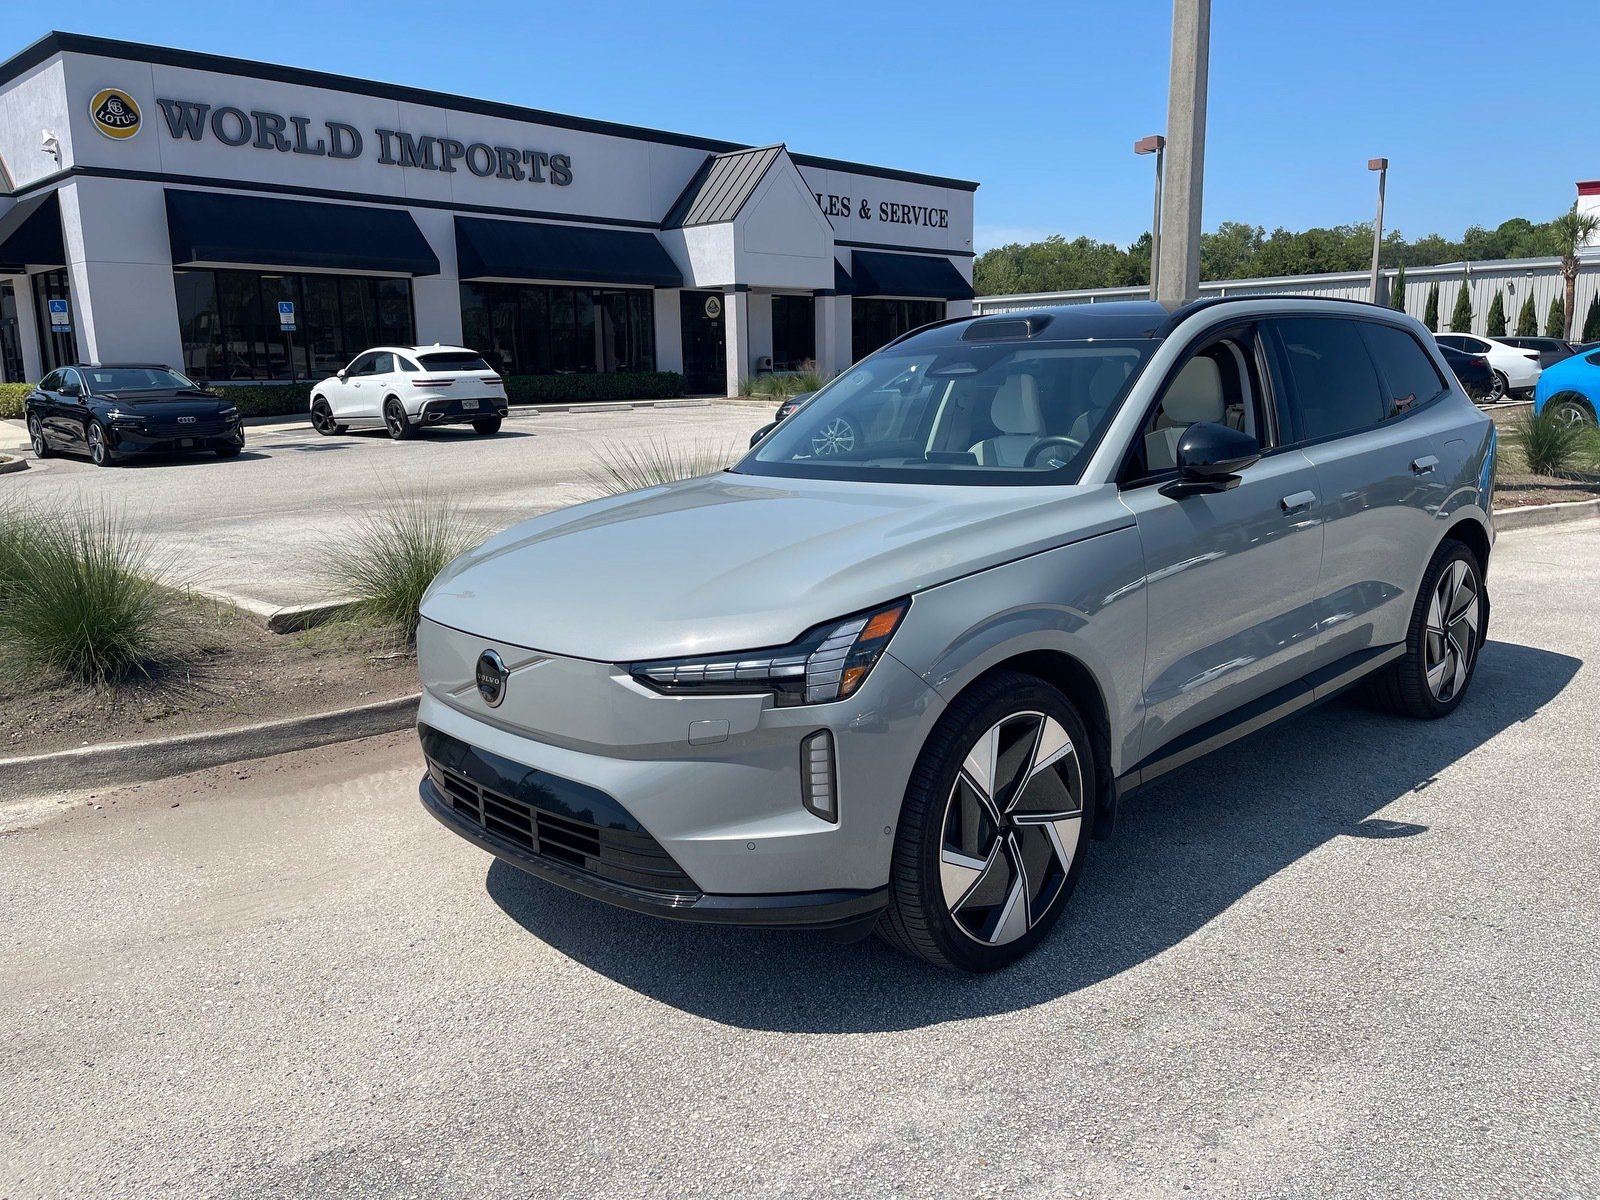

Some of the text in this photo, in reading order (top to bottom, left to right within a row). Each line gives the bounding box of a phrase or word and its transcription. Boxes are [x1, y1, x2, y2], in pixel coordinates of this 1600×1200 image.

[97, 110, 137, 125] LOTUS
[156, 98, 574, 187] WORLD IMPORTS
[859, 199, 872, 220] &
[879, 202, 949, 229] SERVICE
[477, 673, 500, 685] VOLVO
